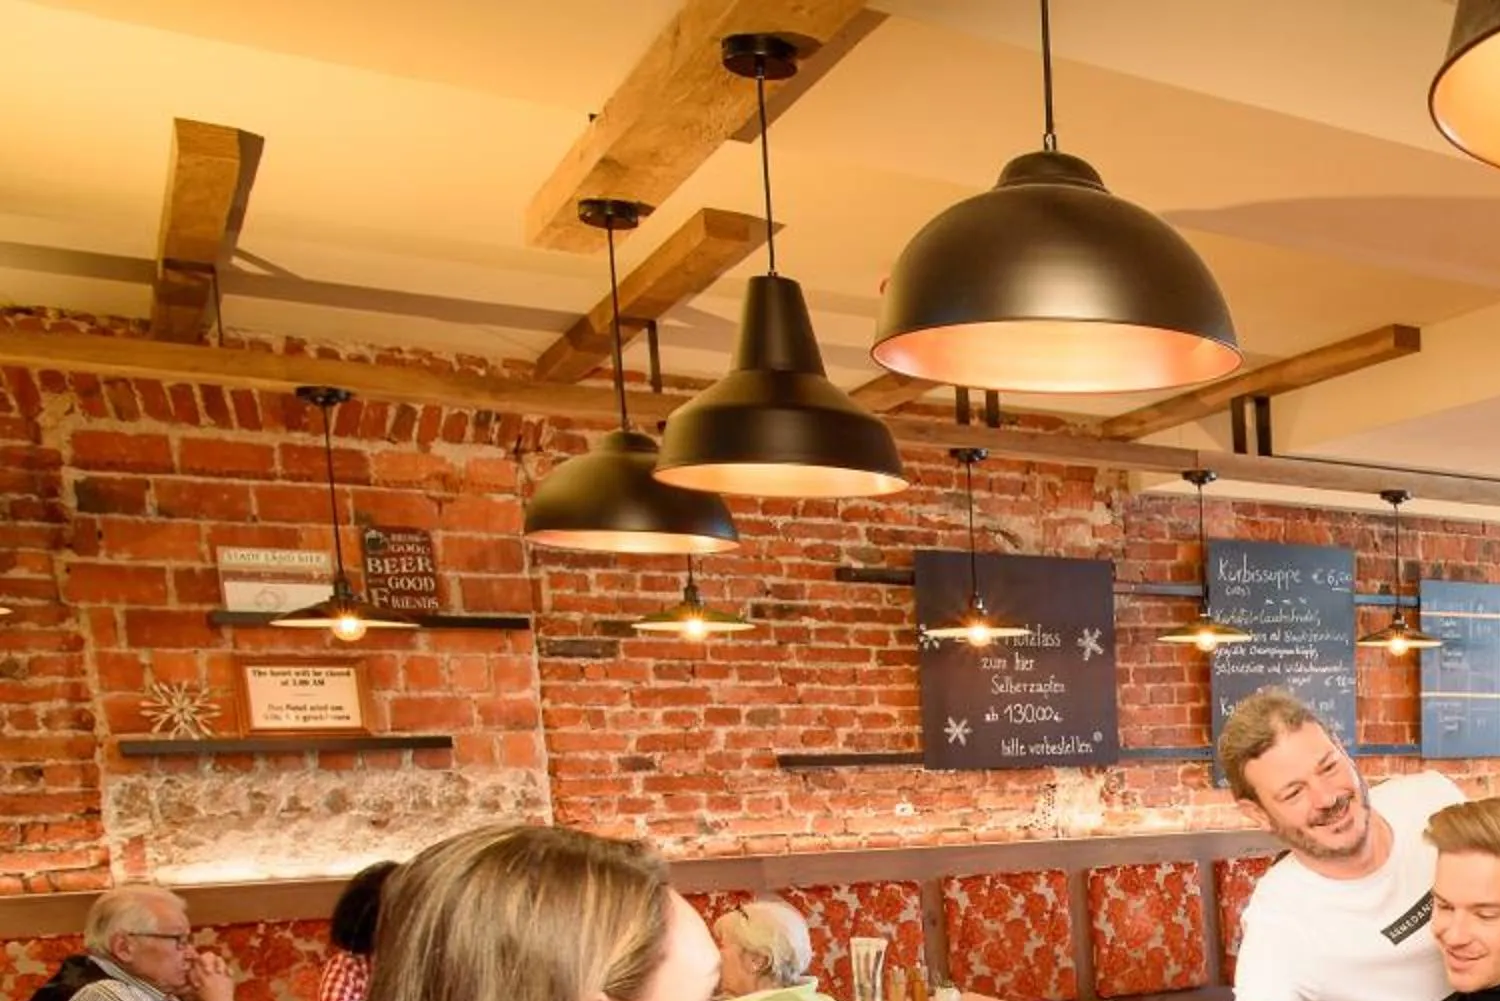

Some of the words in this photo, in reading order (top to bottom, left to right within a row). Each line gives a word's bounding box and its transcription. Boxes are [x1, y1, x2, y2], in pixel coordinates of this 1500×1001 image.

[367, 556, 433, 574] BEER
[387, 576, 435, 591] GOOD
[991, 674, 1066, 699] Selberzapfen
[984, 706, 999, 722] ab
[1001, 736, 1026, 757] bitte
